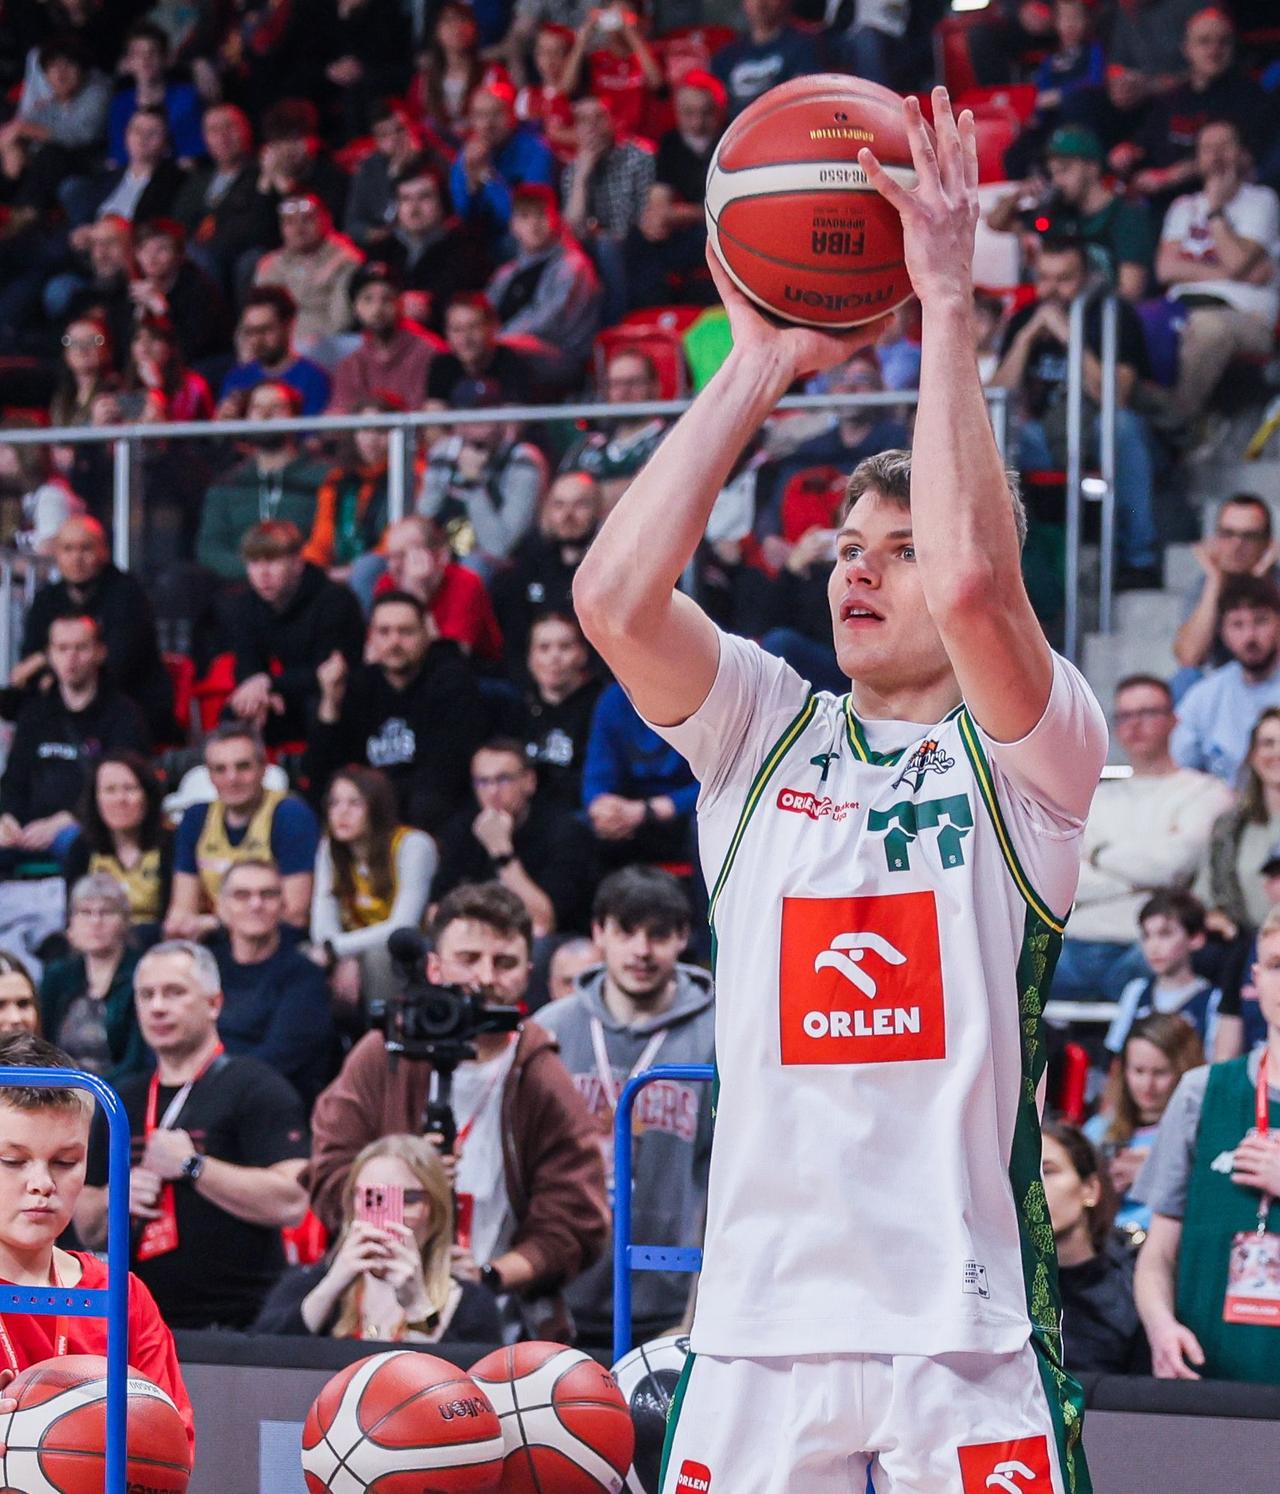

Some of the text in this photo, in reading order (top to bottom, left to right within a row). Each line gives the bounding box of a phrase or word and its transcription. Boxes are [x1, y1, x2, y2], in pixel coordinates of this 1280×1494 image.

[811, 231, 866, 257] FIBA
[784, 284, 896, 313] molten
[867, 793, 974, 872] 77
[803, 1006, 921, 1039] ORLEN
[679, 1473, 709, 1492] ORLEN
